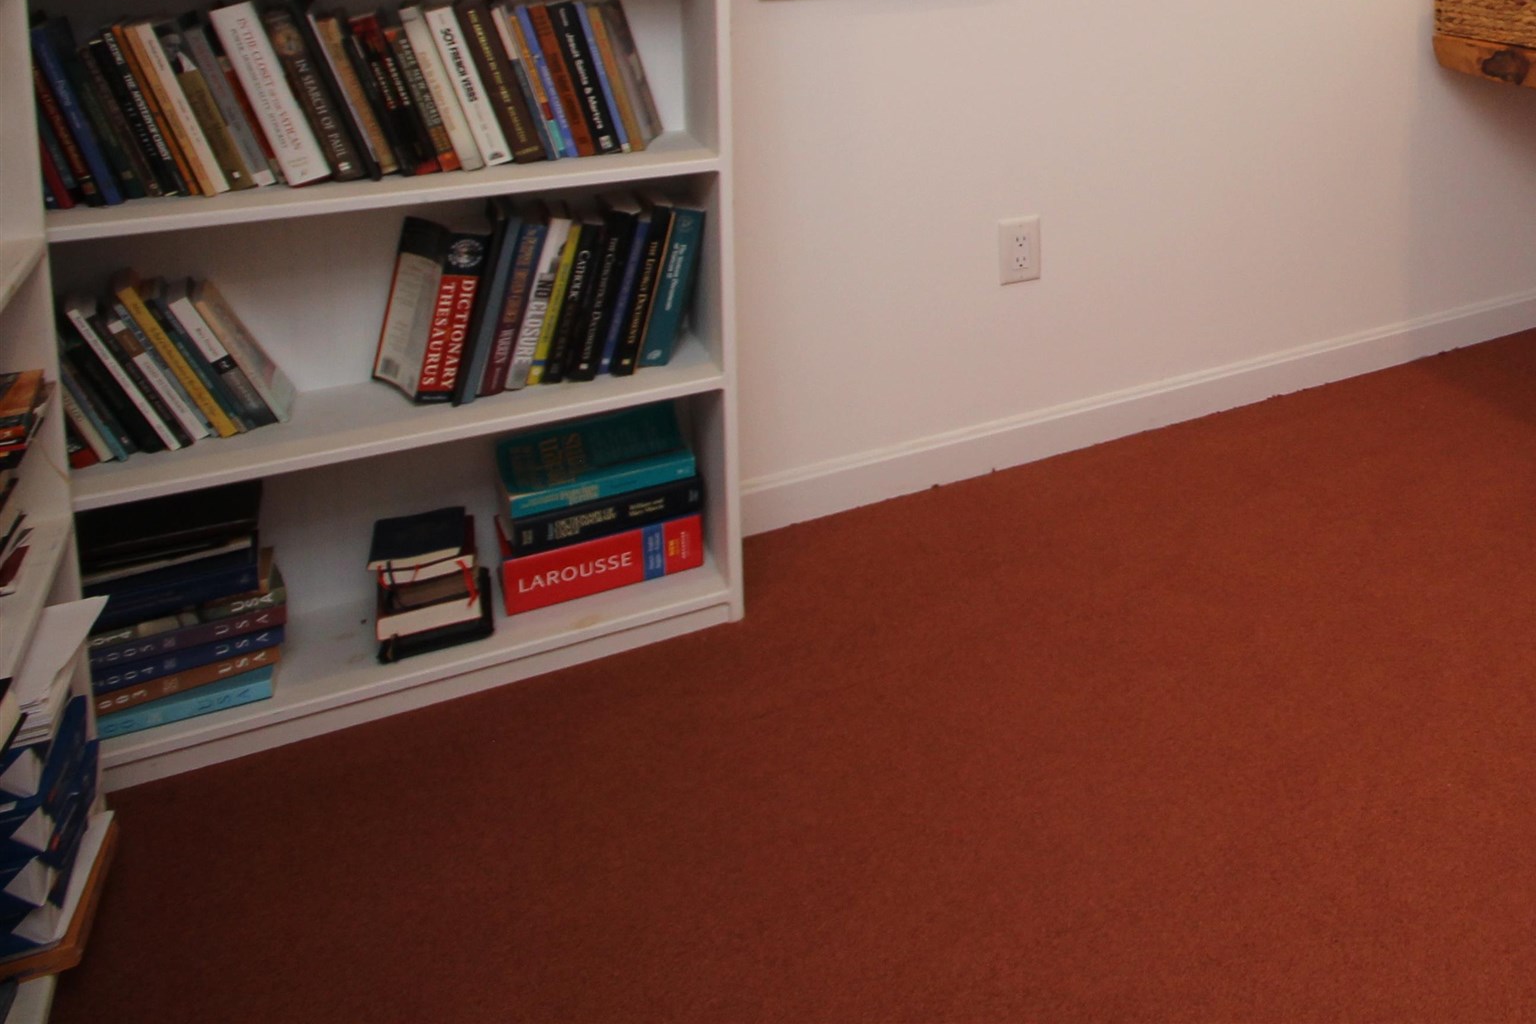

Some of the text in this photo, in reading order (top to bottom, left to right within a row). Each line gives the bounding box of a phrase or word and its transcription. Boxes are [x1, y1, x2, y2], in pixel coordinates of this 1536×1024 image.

[103, 31, 124, 65] KEATING
[446, 45, 467, 76] FRENCH
[460, 76, 478, 104] VERBS
[242, 31, 256, 48] THE
[252, 50, 273, 86] CLOSET
[278, 112, 303, 151] VATICAN
[564, 32, 582, 58] Jesuit
[574, 58, 590, 85] Saints
[587, 95, 605, 130] Martyrs
[131, 90, 151, 123] MYSTERY
[152, 134, 171, 162] CHRIST
[294, 59, 347, 158] IN SEARCH OF PAUL
[420, 91, 443, 126] WORLD
[568, 248, 591, 301] CATHOLIC
[421, 280, 457, 387] THESAURUS
[440, 277, 475, 390] DICTIONARY
[515, 277, 553, 365] NO CLOSURE
[582, 309, 602, 360] DOCUMENTS
[626, 291, 647, 345] DOCUMENTS
[494, 326, 514, 364] WARREN
[518, 551, 633, 593] LAROUSSE
[215, 613, 269, 636] USA
[231, 591, 274, 613] USA
[215, 632, 270, 655] USA
[219, 651, 267, 675] USA
